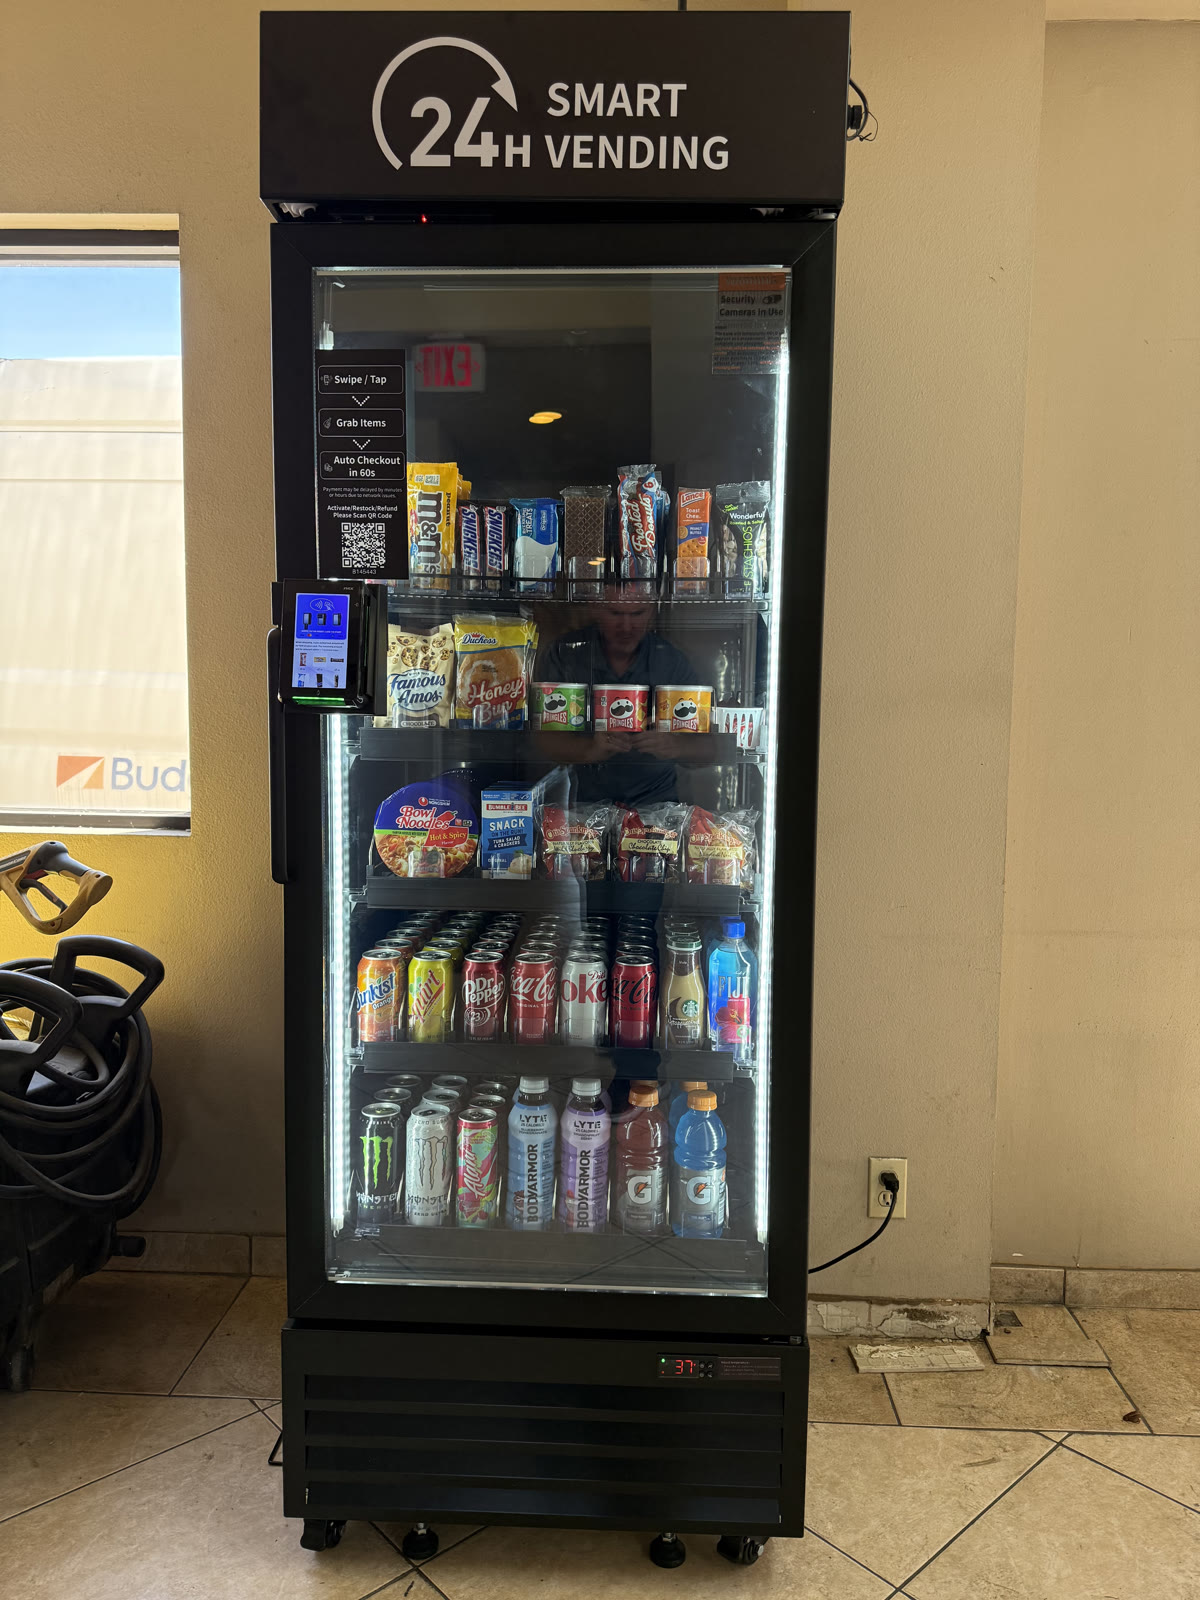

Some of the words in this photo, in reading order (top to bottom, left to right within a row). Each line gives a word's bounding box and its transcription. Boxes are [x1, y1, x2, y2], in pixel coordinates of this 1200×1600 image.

[547, 82, 687, 117] SMART
[544, 134, 730, 171] VENDING
[720, 295, 756, 305] Security
[719, 308, 756, 317] Cameras
[768, 308, 784, 316] Use
[334, 374, 363, 386] Swipe
[369, 375, 388, 386] Tap
[336, 418, 359, 428] Grab
[360, 418, 387, 428] Items
[333, 456, 356, 465] Auto
[357, 455, 401, 465] Checkout
[348, 467, 358, 477] in
[359, 468, 376, 478] 60s
[643, 481, 654, 489] 6
[526, 508, 534, 534] TREATS
[729, 511, 765, 520] Wonderful
[626, 500, 648, 552] Frosted
[461, 507, 480, 570] SNICKERS
[486, 507, 504, 572] SNICKERS
[461, 633, 497, 645] Duchess
[387, 673, 446, 698] Famous
[468, 679, 523, 704] Honey
[397, 689, 443, 707] Amos
[478, 700, 513, 723] Bun
[543, 711, 568, 724] PRINGLES
[609, 717, 634, 729] PRINGLES
[672, 718, 698, 731] PRINGLES
[400, 805, 437, 818] Bowl
[396, 816, 451, 829] Noodles
[489, 818, 525, 831] SNACK
[497, 840, 521, 848] CRACKERS
[628, 842, 657, 851] Chocolate
[657, 844, 671, 853] Chip
[475, 977, 495, 992] Dr
[718, 975, 751, 998] FIJI
[465, 980, 503, 1006] Pepper
[469, 1011, 481, 1022] 23
[573, 1120, 601, 1129] LYTE
[526, 1144, 539, 1223] BODYARMOR
[577, 1149, 591, 1228] BODYARMOR
[627, 1175, 653, 1205] G
[686, 1176, 711, 1205] G
